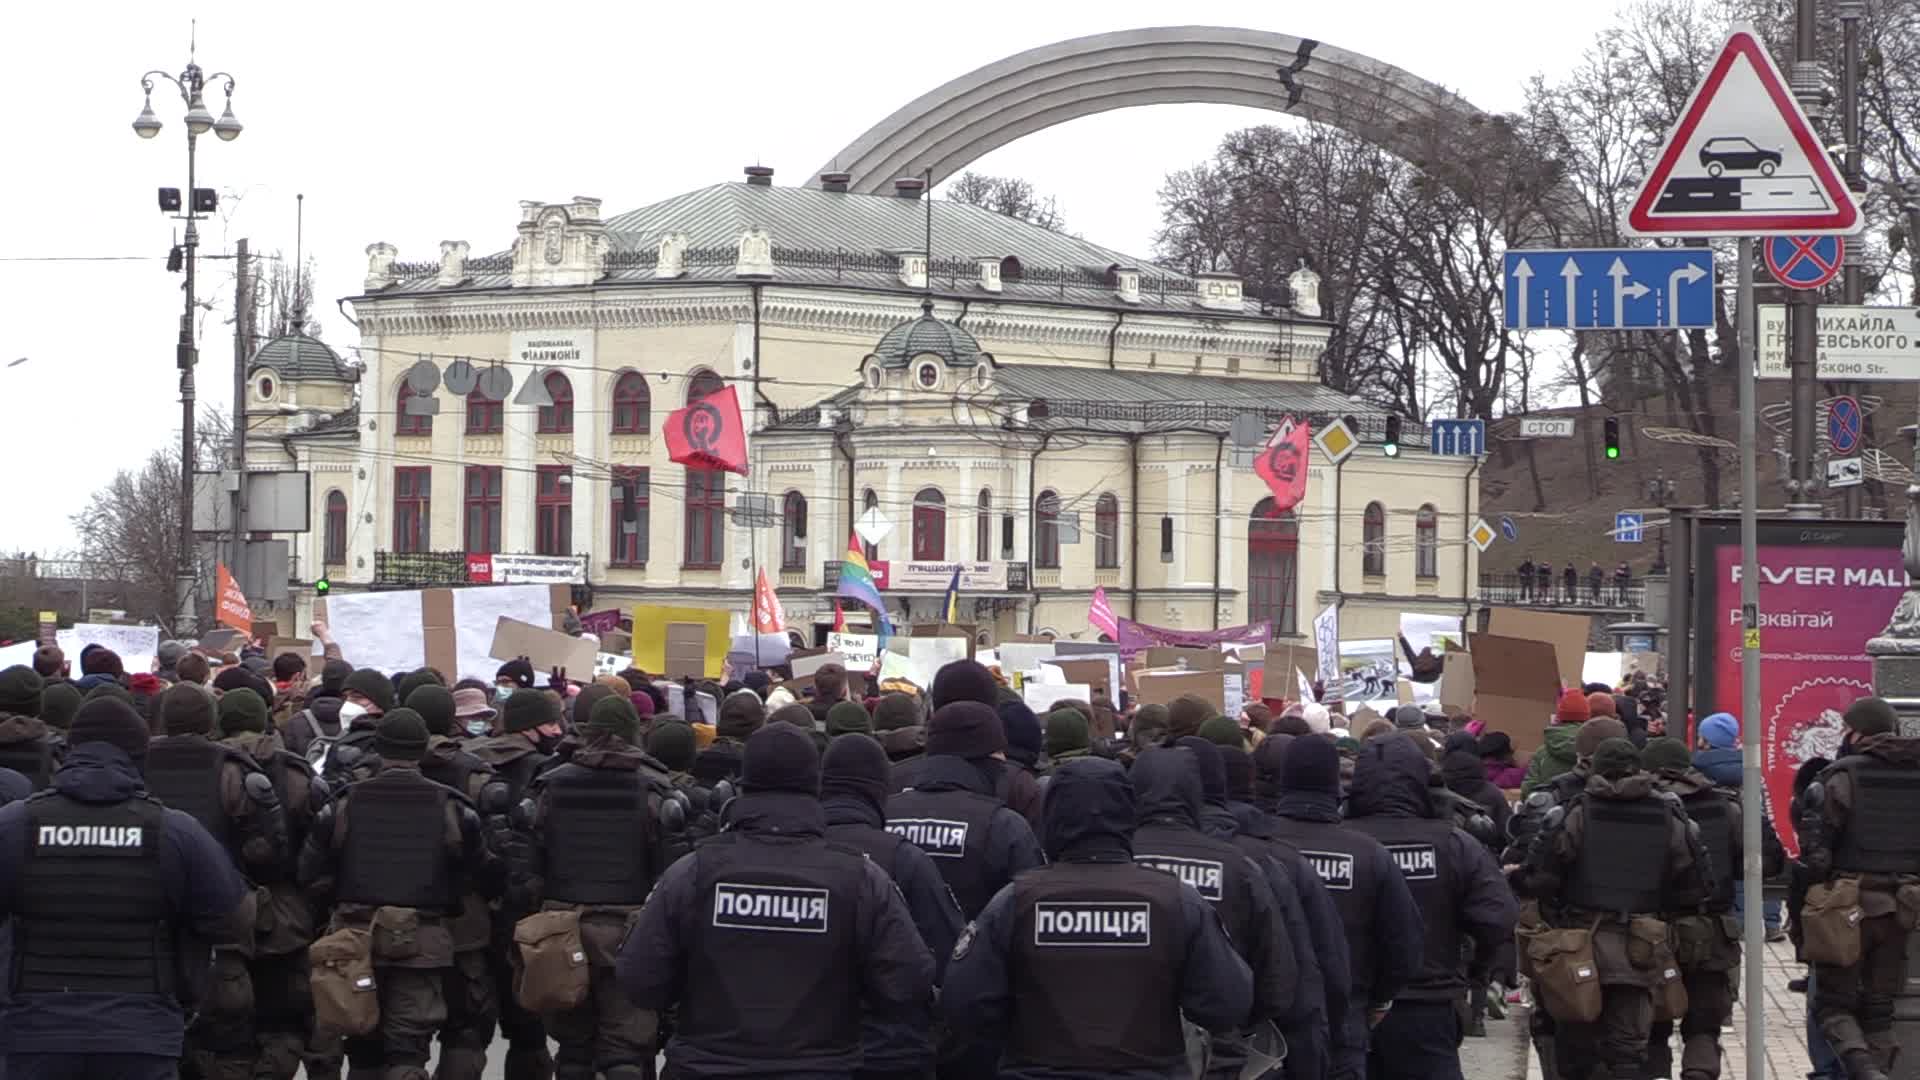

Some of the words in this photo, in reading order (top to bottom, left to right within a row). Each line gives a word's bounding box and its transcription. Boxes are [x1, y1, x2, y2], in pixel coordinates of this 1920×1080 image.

[1528, 422, 1565, 433] СТОП
[1730, 608, 1833, 628] Рзквітай
[38, 826, 142, 847] ПОЛІЦІЯ
[717, 892, 825, 922] ПОЛІЦІЯ
[1038, 911, 1147, 937] ПОЛІЦІЯ
